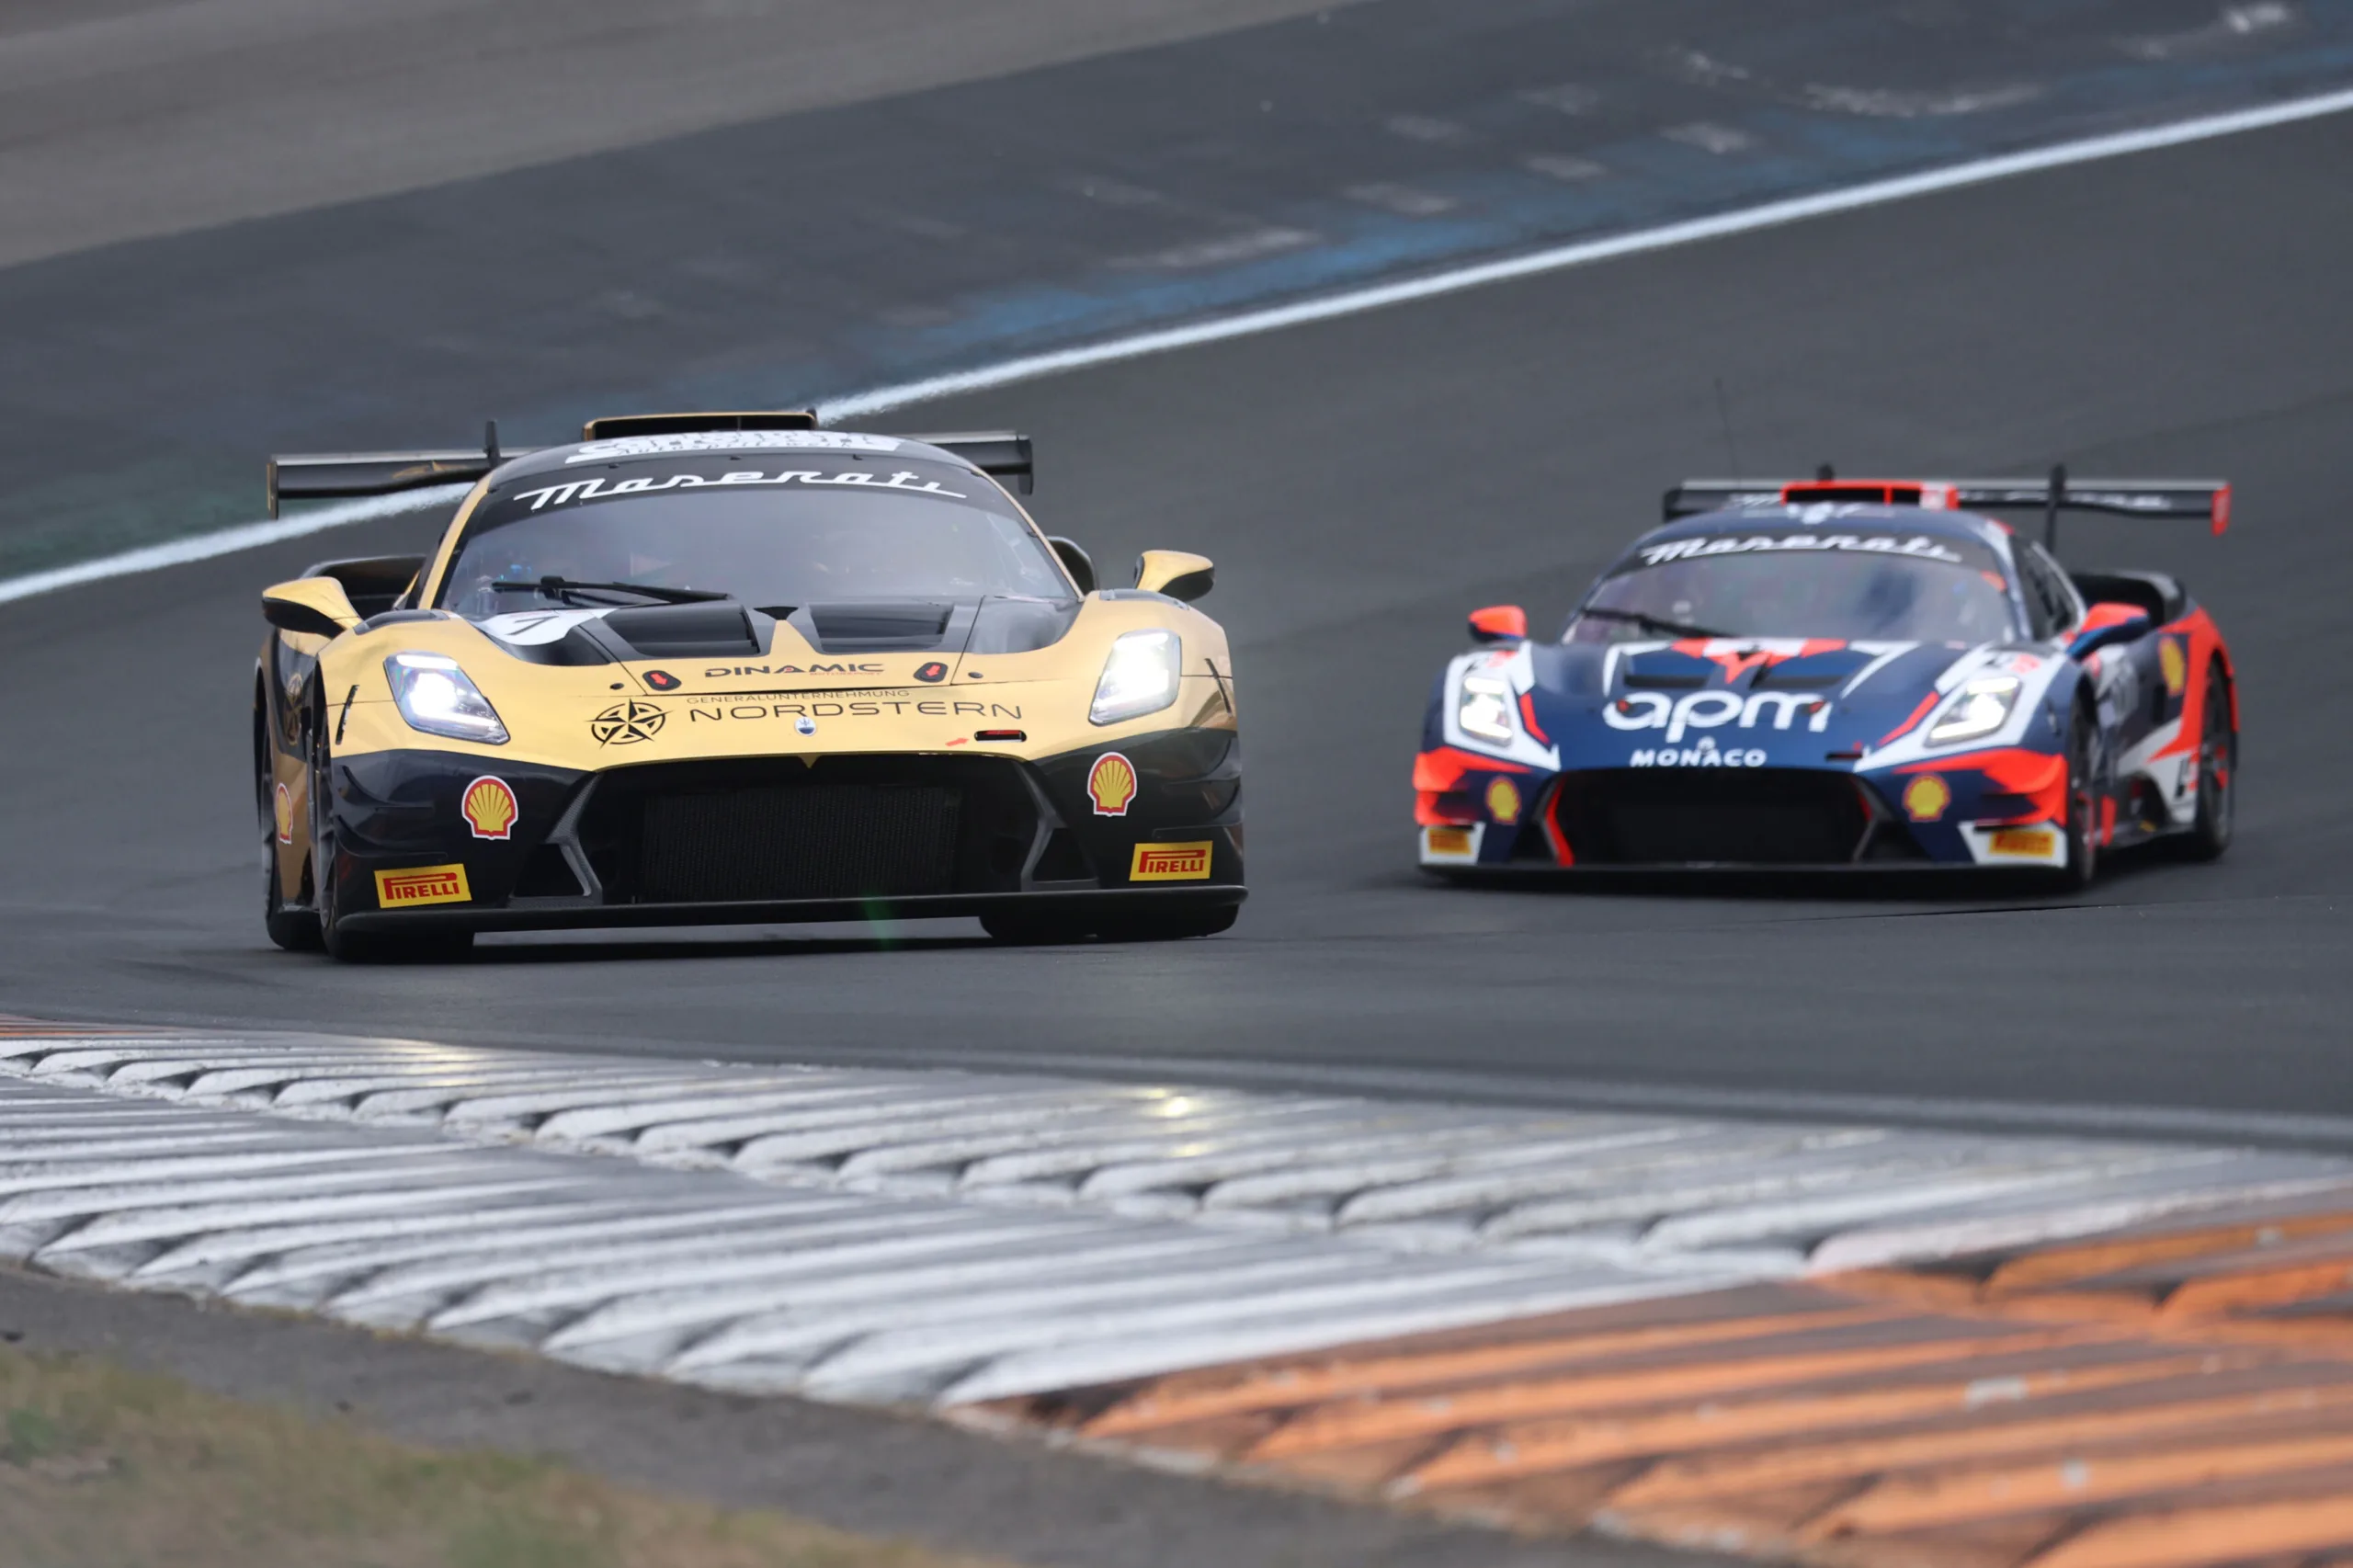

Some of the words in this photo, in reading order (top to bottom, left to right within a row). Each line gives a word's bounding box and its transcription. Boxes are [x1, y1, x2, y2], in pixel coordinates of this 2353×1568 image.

[514, 470, 967, 510] Maserati
[704, 663, 885, 677] DINAMIC
[687, 689, 910, 704] GENERALUNTERNEHMUNG
[689, 701, 1023, 722] NORDSTERN
[1602, 689, 1833, 744] apm
[1630, 748, 1768, 768] MONACO
[1138, 848, 1207, 874] PIRELLI
[382, 871, 460, 901] PIRELLI
